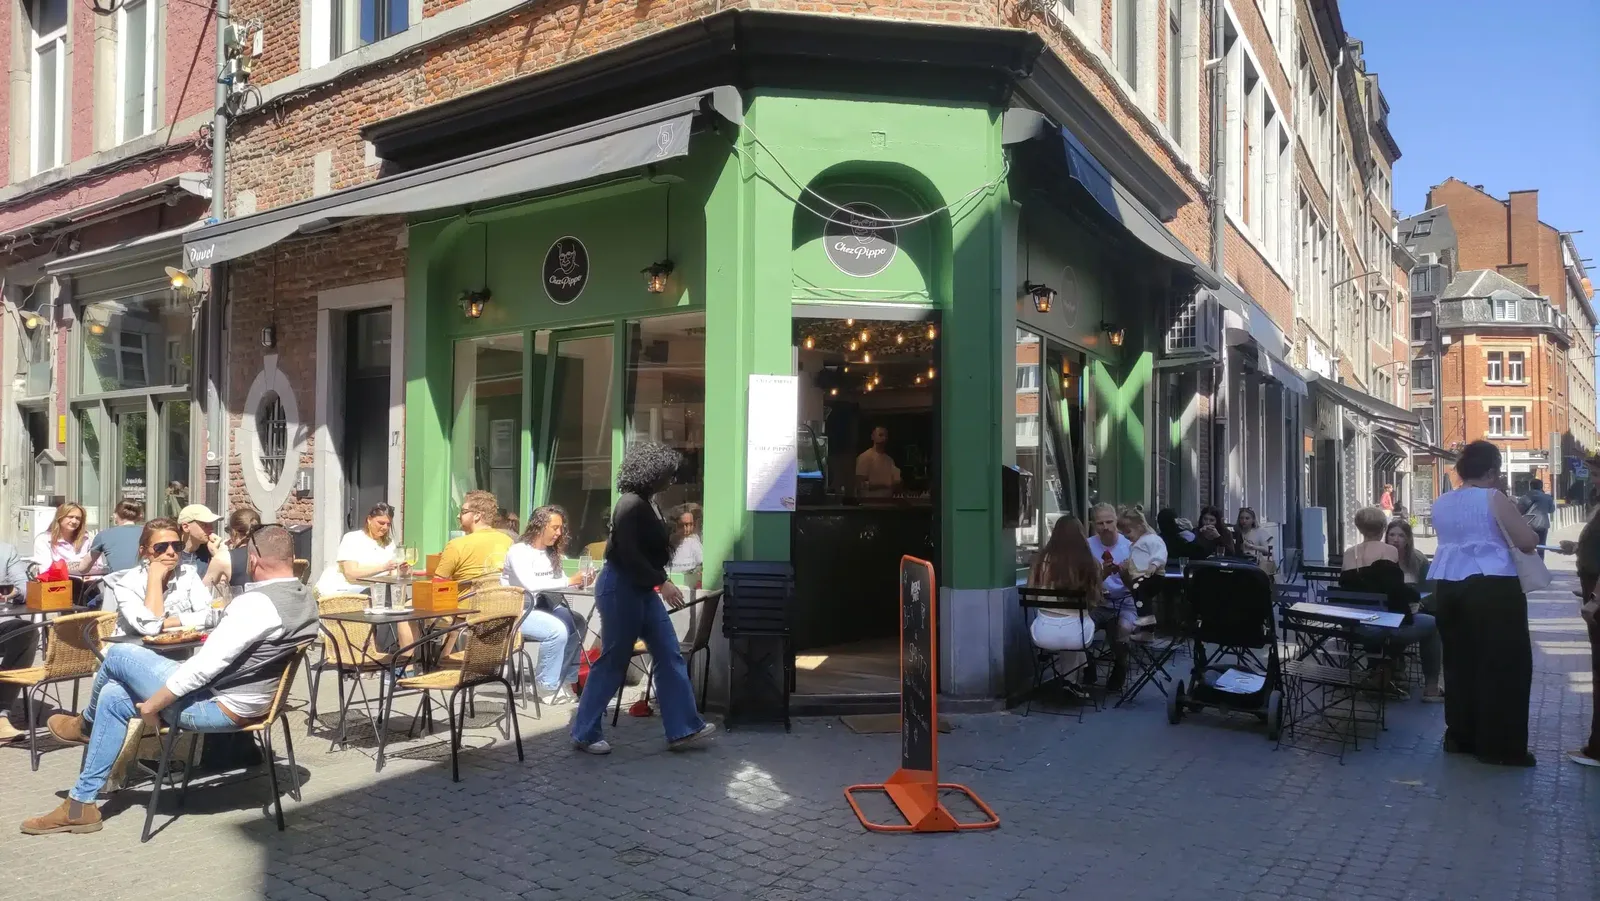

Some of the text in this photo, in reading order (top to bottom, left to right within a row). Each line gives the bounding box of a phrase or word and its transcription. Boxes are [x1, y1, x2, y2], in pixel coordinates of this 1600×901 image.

[190, 243, 215, 262] Duvel
[834, 241, 887, 260] Chez Pippo
[561, 275, 582, 290] Pippo
[391, 430, 400, 447] 17
